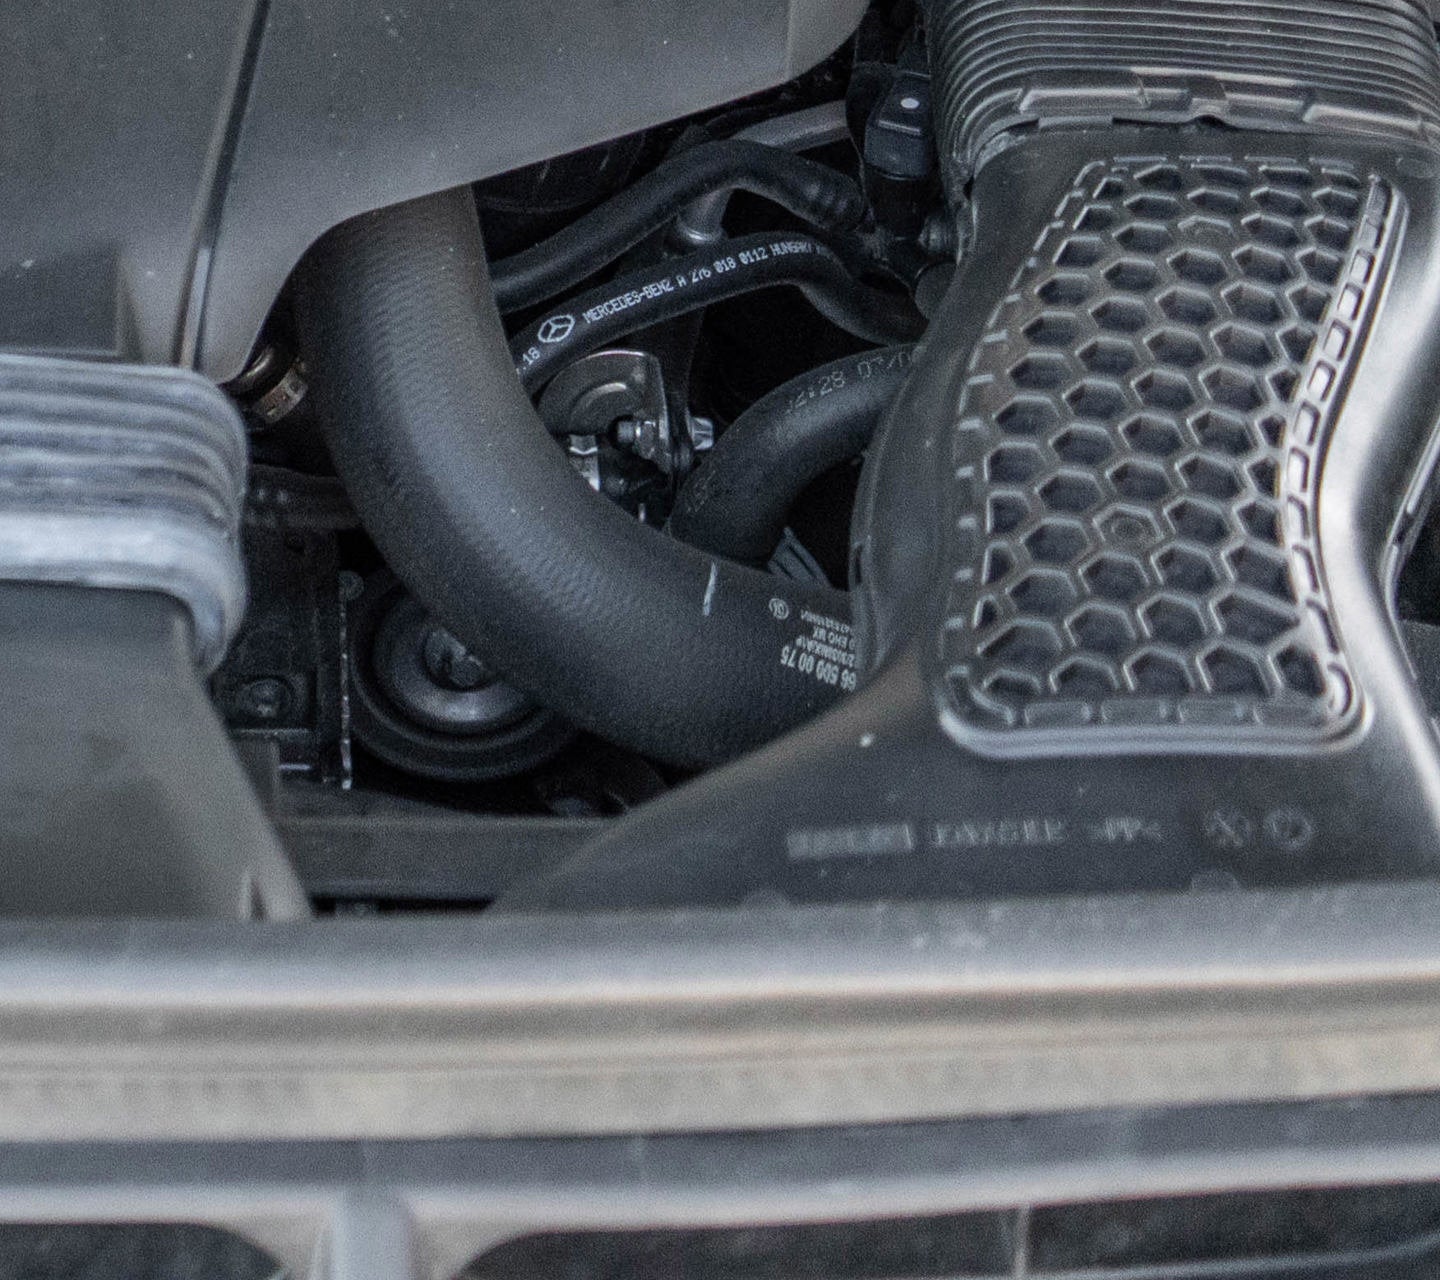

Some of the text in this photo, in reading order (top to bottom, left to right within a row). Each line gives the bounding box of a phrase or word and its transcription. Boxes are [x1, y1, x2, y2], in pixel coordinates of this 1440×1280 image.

[583, 278, 675, 325] MERCEDES-BENZ
[676, 273, 688, 288] A
[712, 255, 738, 276] 018
[737, 243, 769, 268] 0112
[780, 645, 796, 668] 75
